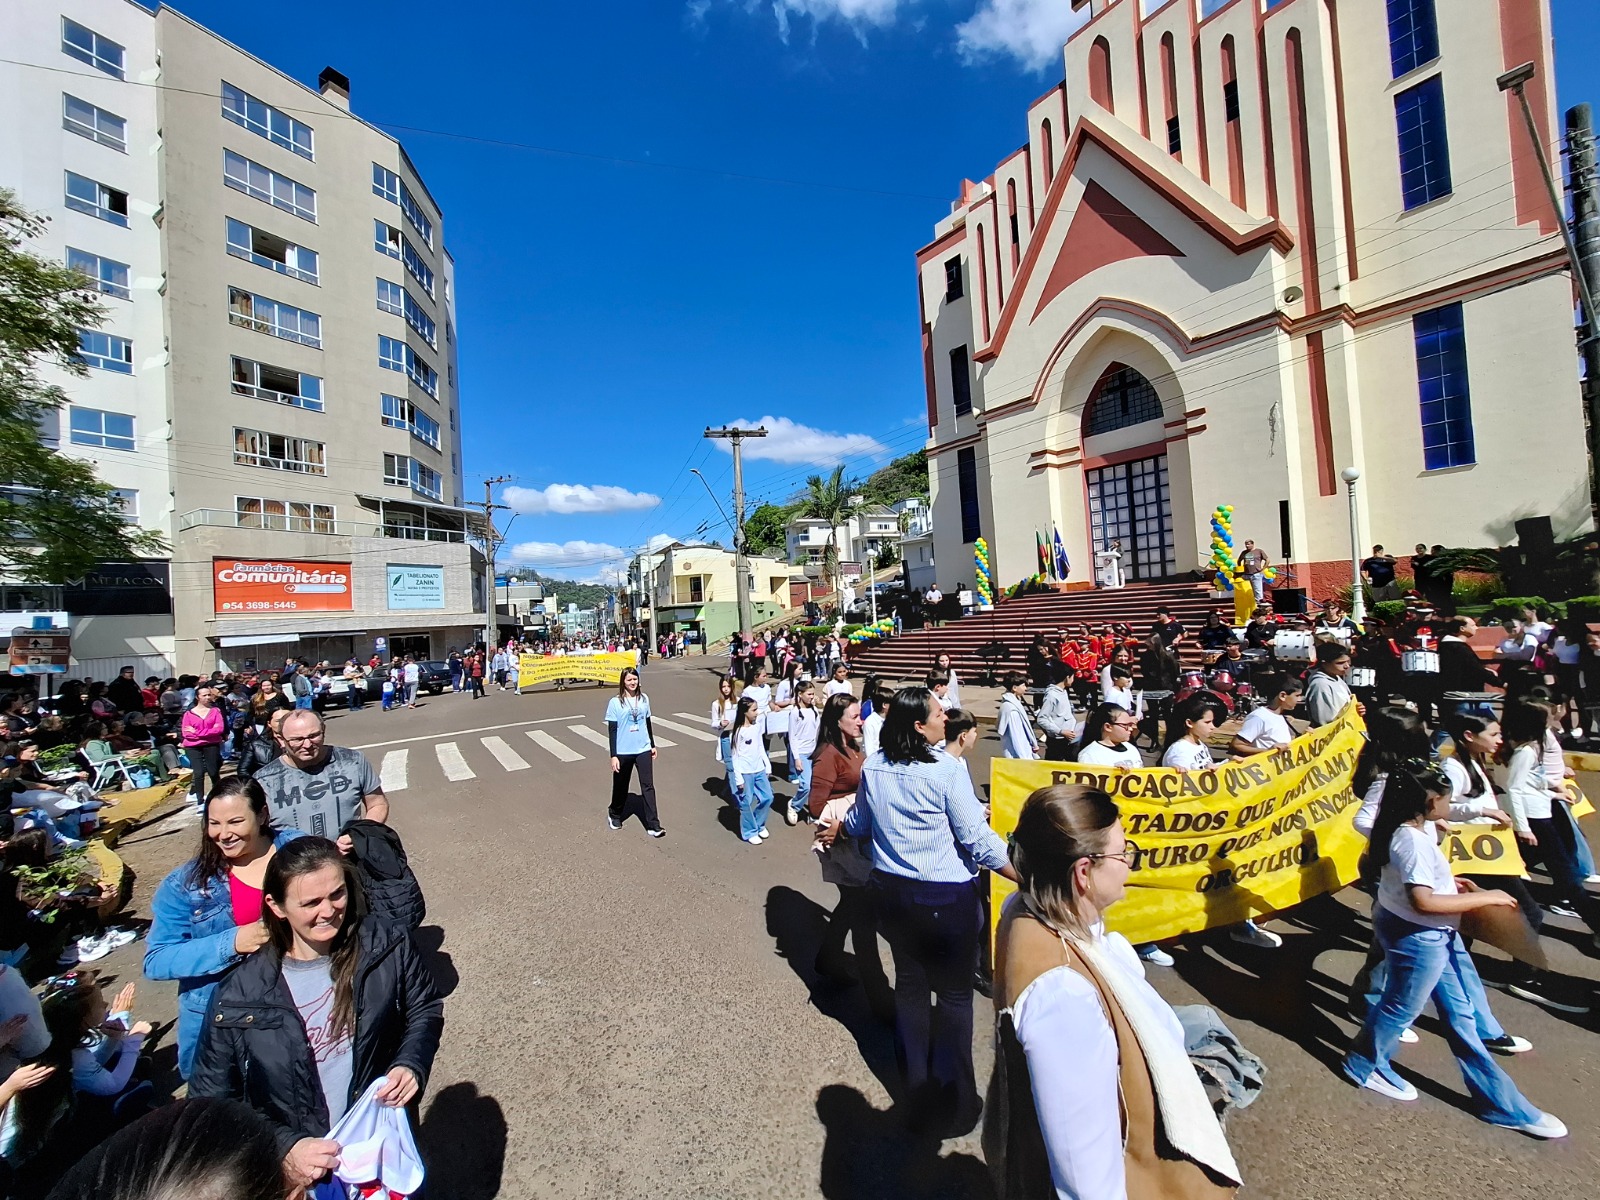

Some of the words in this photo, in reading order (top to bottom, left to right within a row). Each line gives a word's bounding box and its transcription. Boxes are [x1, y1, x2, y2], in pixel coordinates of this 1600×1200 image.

[218, 569, 347, 584] Comunitária
[230, 601, 244, 610] 54
[246, 601, 297, 610] 3698-5445
[533, 671, 575, 681] COMUNIDADE
[1223, 762, 1272, 798] QUE
[1118, 810, 1229, 835] TADOS
[1234, 796, 1277, 829] QUE
[1130, 842, 1210, 872] TURO
[1216, 826, 1266, 860] QUE
[1267, 808, 1308, 840] NOS
[1447, 829, 1504, 864] ÃO
